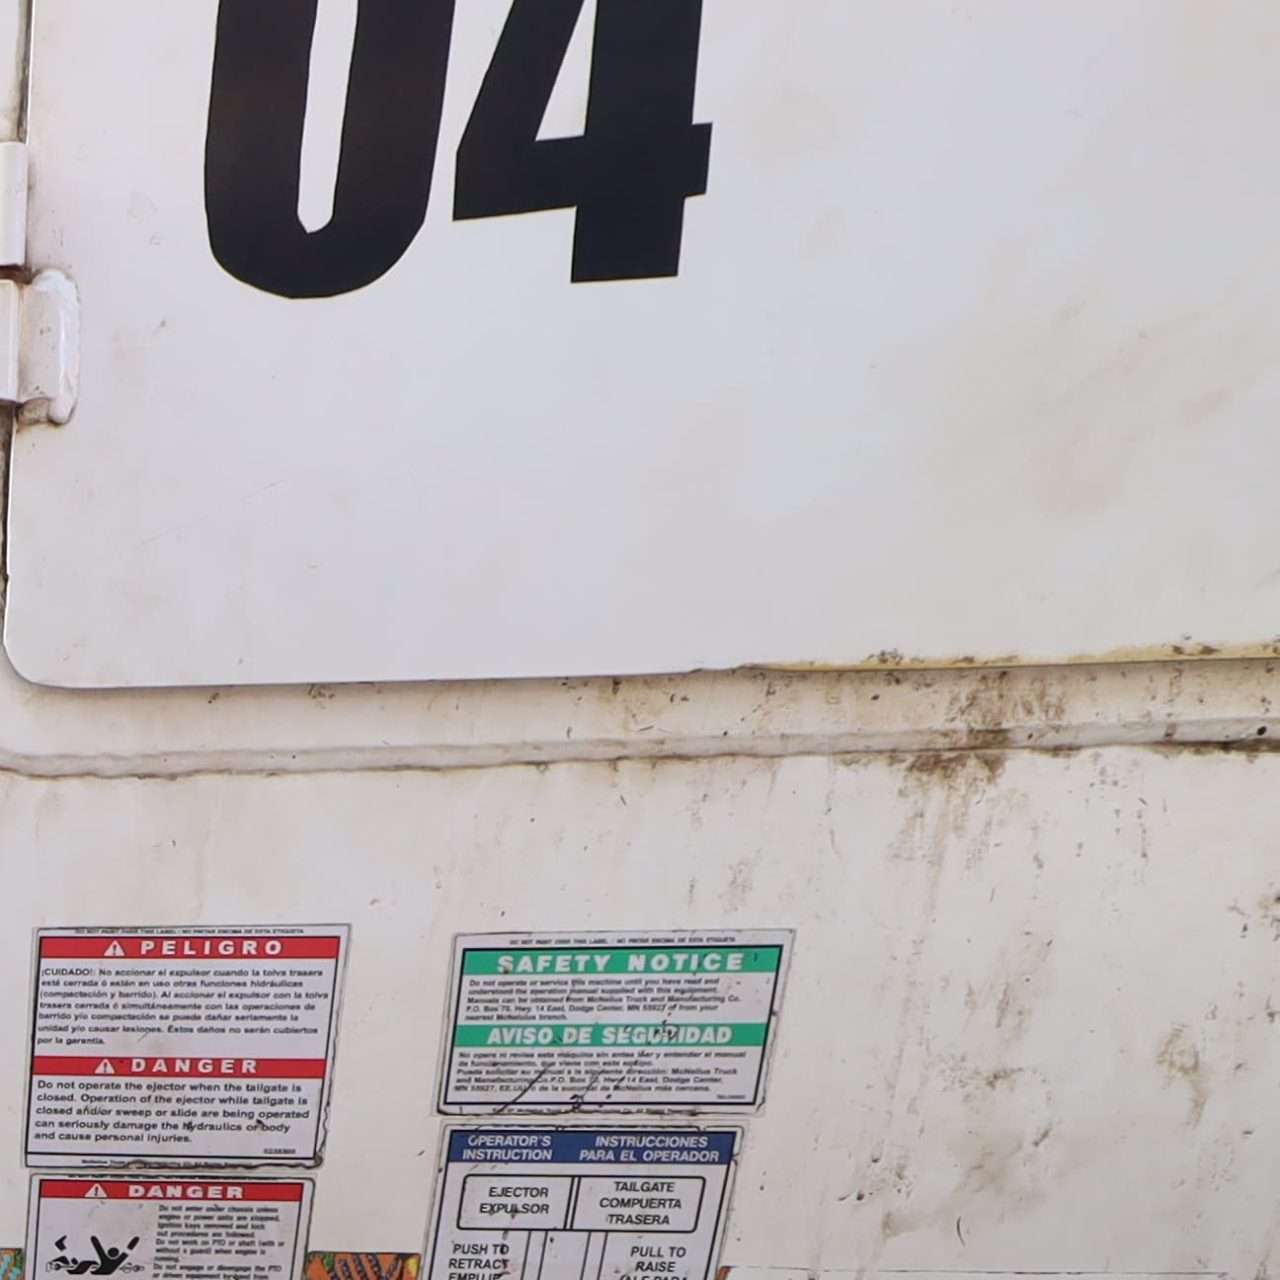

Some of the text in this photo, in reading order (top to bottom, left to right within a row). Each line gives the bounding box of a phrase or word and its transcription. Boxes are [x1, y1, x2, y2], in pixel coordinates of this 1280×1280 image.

[204, 0, 713, 300] 04
[140, 940, 282, 955] PELIGRO
[498, 953, 743, 972] SAFETY NOTICE
[488, 1026, 732, 1045] AVISO DE SEGURIDAD
[131, 1058, 257, 1073] DANGER
[38, 1080, 53, 1089] Do
[57, 1081, 75, 1089] not
[595, 1136, 708, 1148] INSTRUCCIONES
[463, 1149, 552, 1160] INSTRUCTION
[579, 1150, 719, 1161] PARA EL OPERADOR
[128, 1184, 244, 1199] DANGER
[489, 1187, 549, 1197] EJECTOR
[614, 1181, 675, 1192] TAILGATE
[480, 1203, 549, 1214] EXPULSOR
[600, 1198, 682, 1209] COMPUERTA
[608, 1214, 670, 1225] TRASERA
[453, 1244, 510, 1255] PUSH TO
[630, 1247, 686, 1258] PULL TO
[449, 1259, 510, 1269] RETRACT
[635, 1261, 676, 1272] RAISE
